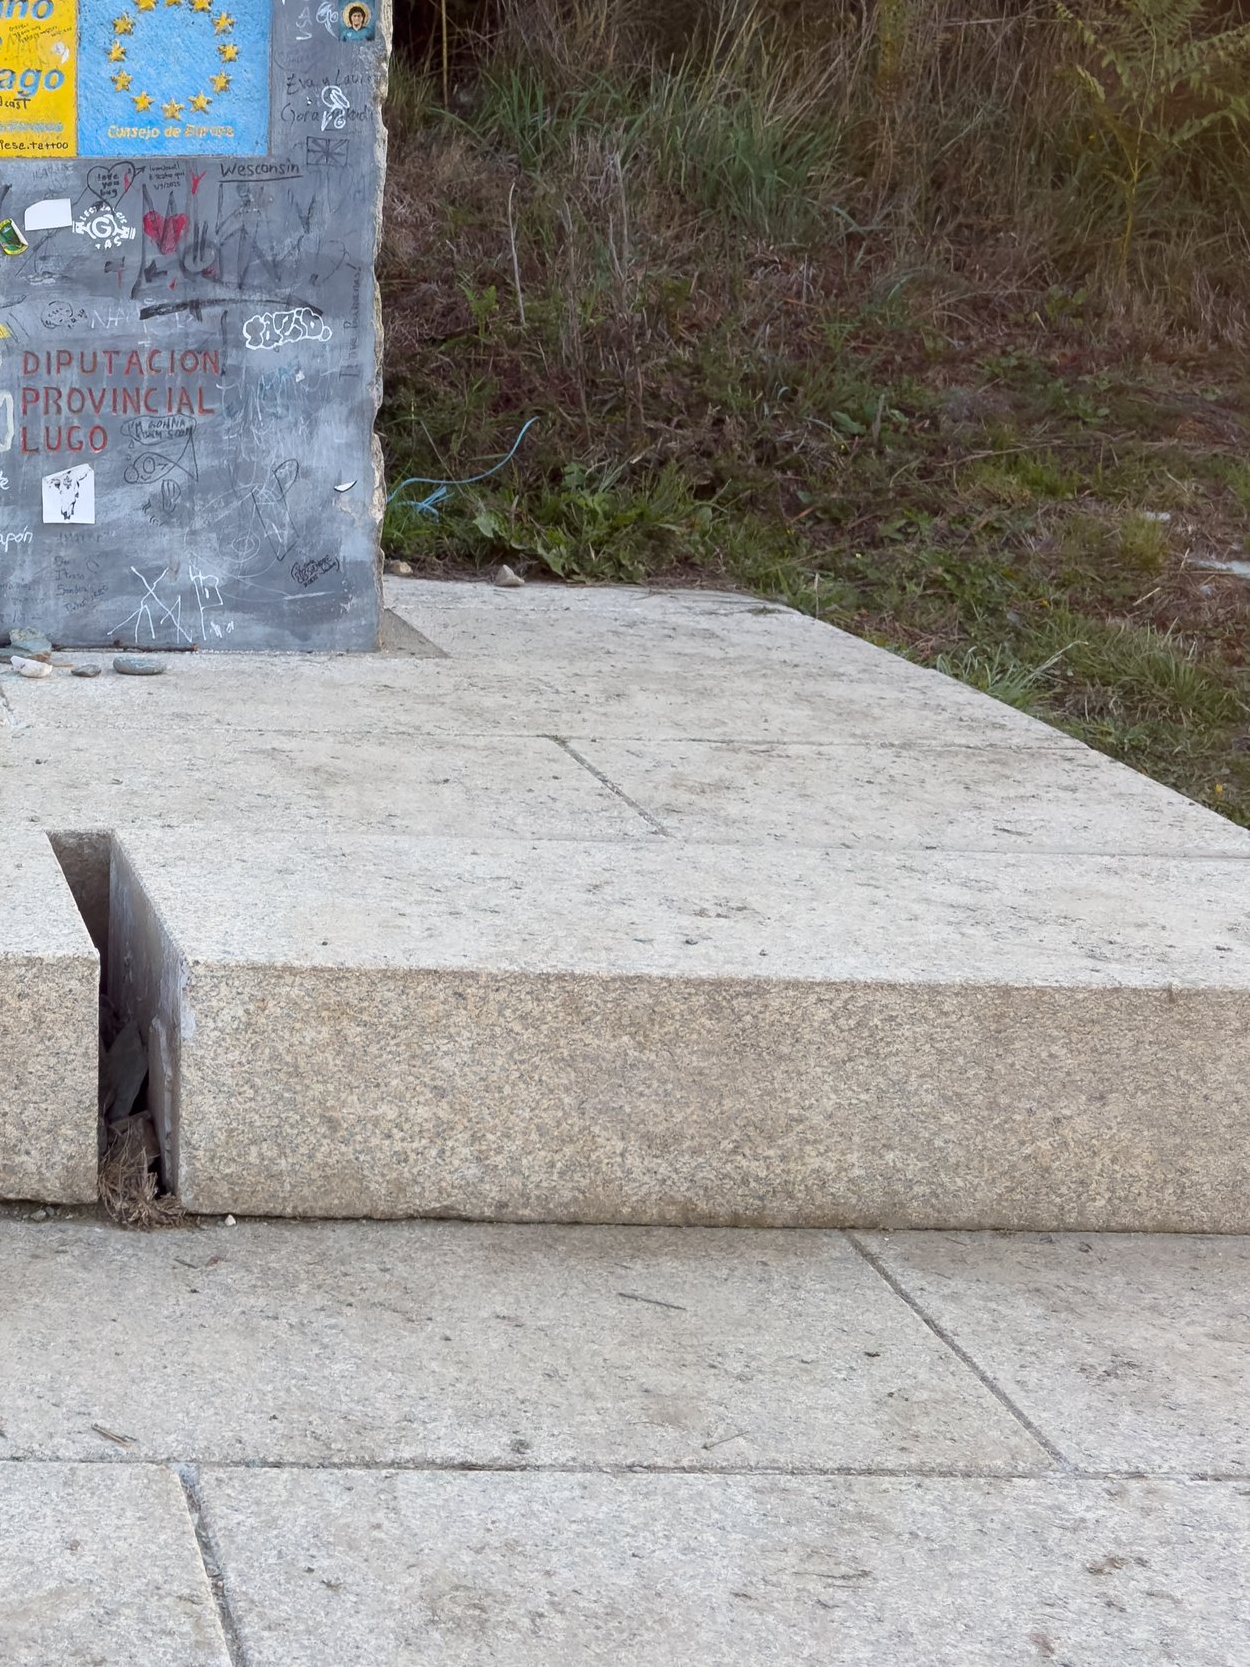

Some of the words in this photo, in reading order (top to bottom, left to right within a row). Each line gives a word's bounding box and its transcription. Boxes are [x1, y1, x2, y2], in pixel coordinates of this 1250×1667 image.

[107, 124, 161, 141] Consejo
[163, 125, 182, 138] de
[21, 348, 221, 377] DIPUTACION
[21, 385, 216, 417] PROVINCIAL
[21, 424, 109, 455] LUGO
